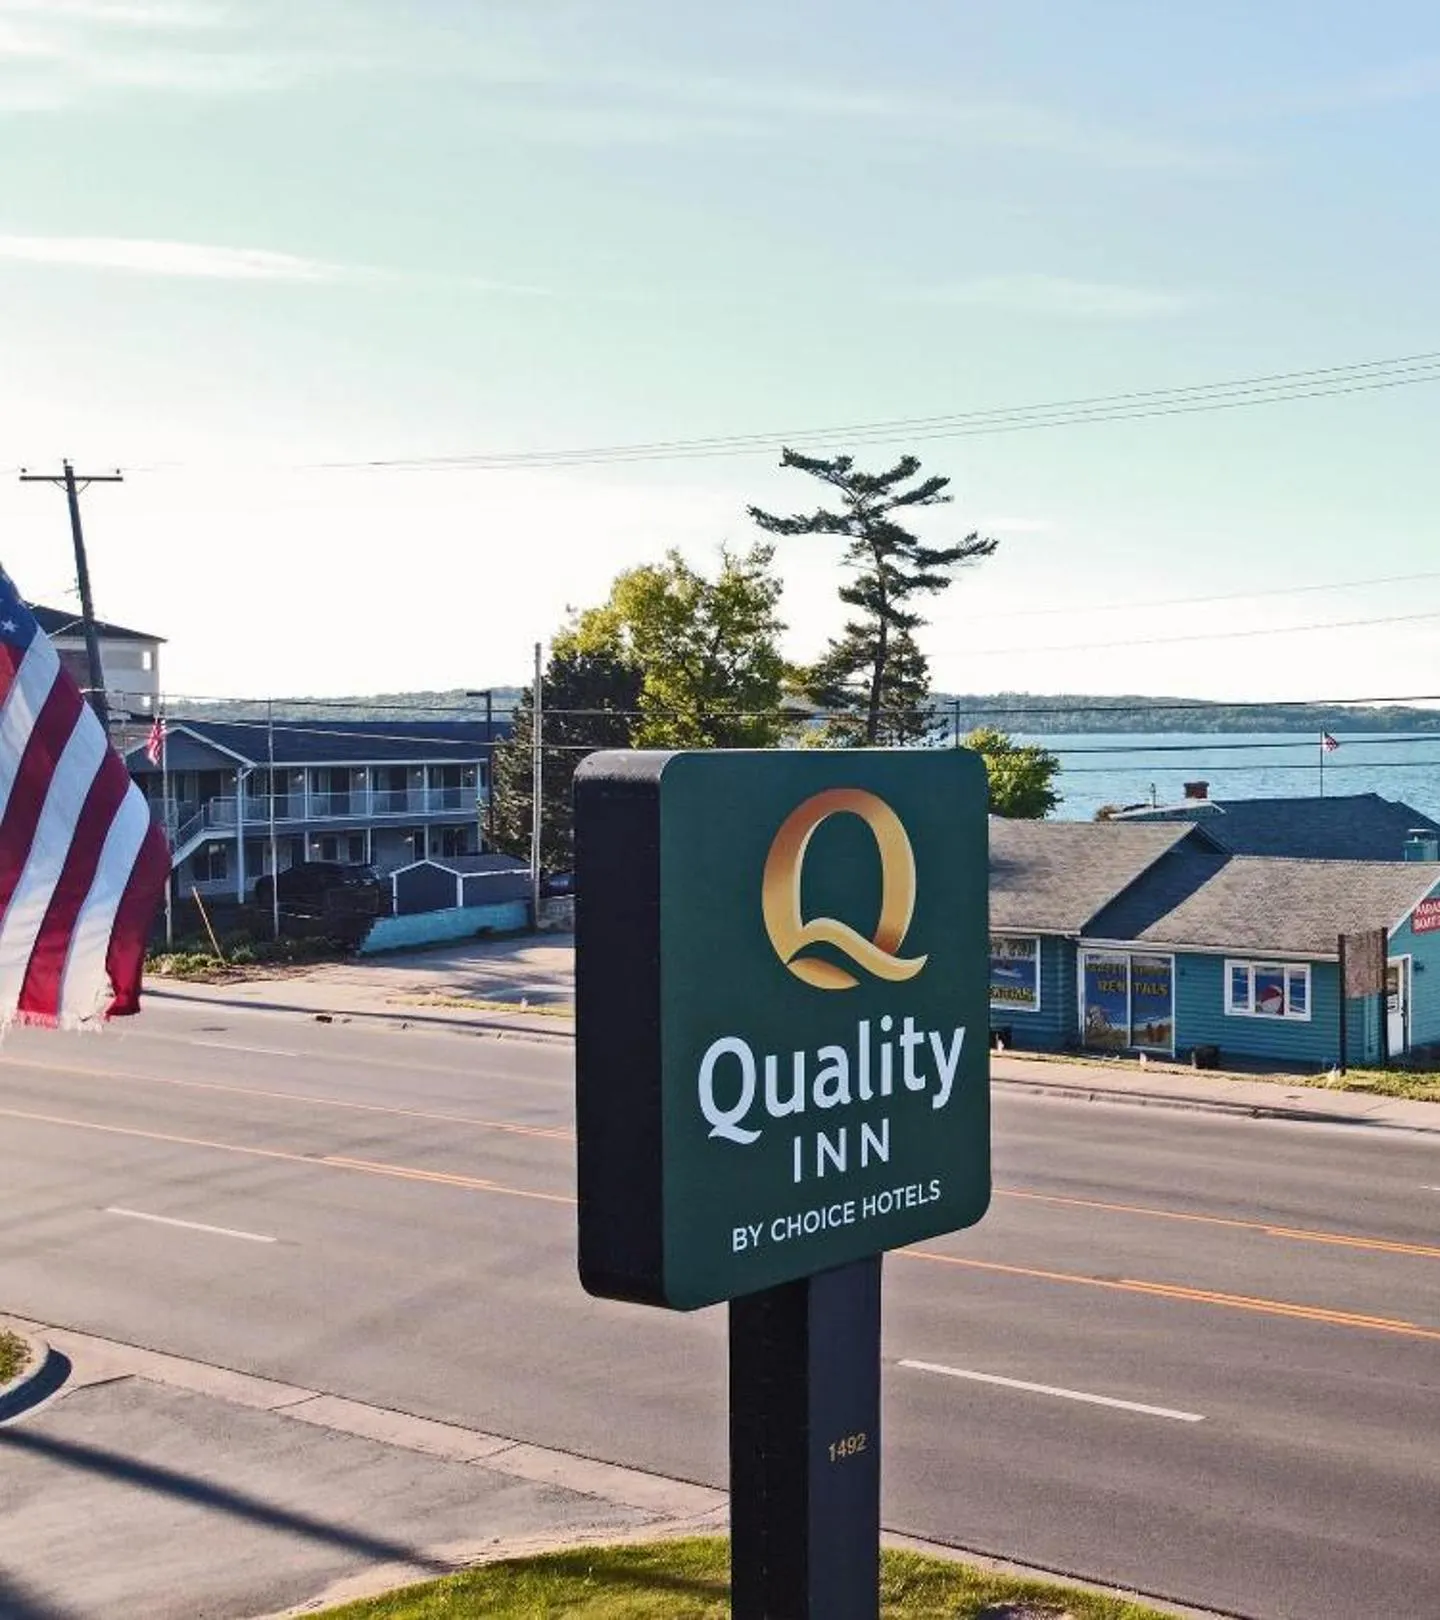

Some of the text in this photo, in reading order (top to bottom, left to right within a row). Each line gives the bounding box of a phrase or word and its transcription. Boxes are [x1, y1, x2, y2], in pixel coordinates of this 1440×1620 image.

[762, 788, 928, 989] Q
[698, 1015, 966, 1144] Quality
[794, 1118, 889, 1183] INN
[732, 1179, 941, 1252] BY CHOICE HOTELS
[828, 1432, 867, 1462] 1492
